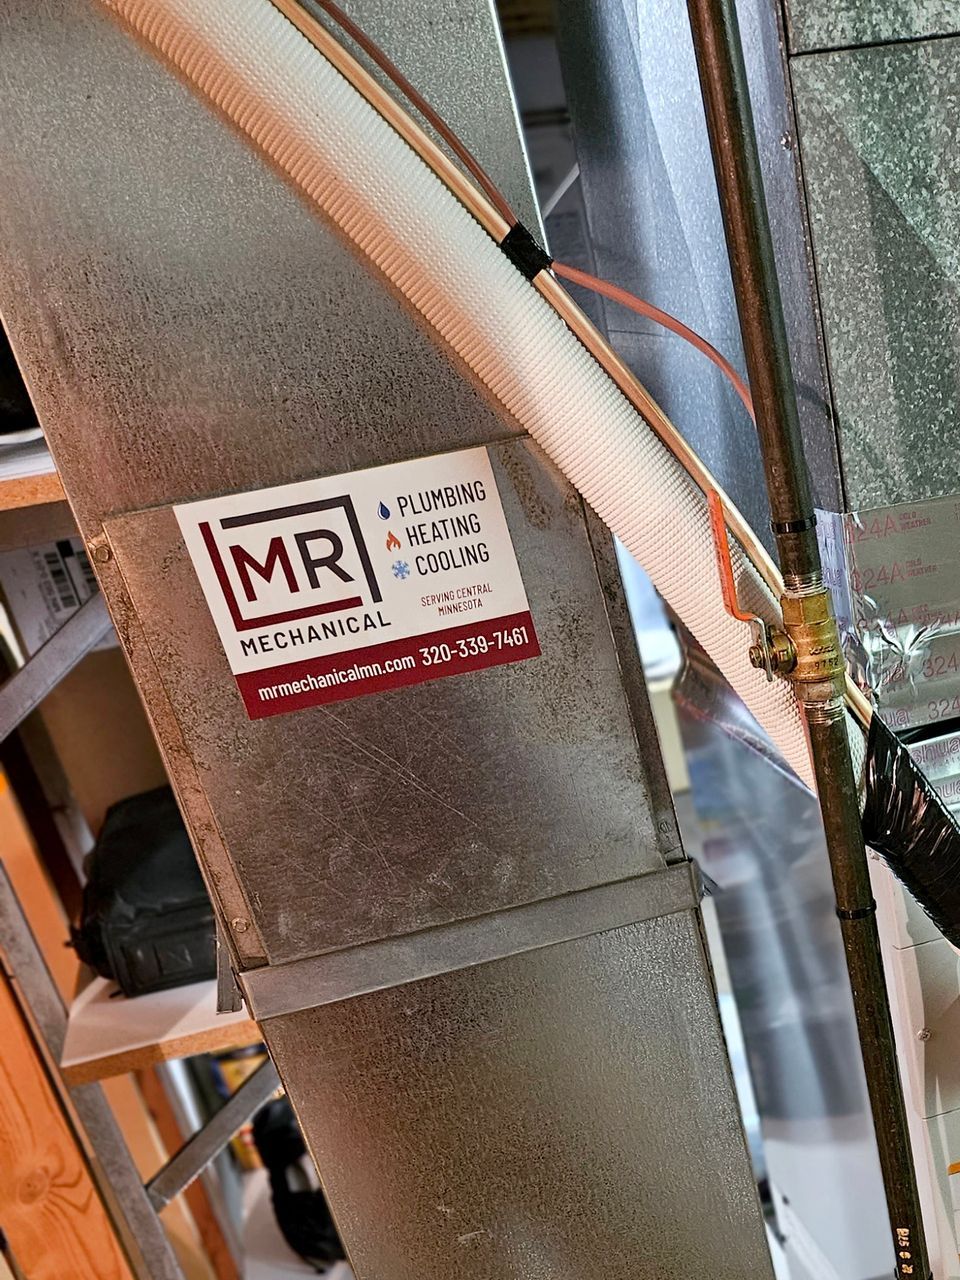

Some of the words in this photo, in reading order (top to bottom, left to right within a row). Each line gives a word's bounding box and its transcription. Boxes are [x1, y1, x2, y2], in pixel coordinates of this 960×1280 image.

[397, 481, 487, 517] PLUMBING
[405, 513, 481, 547] HEATING
[229, 528, 355, 602] MR
[415, 542, 490, 576] COOLING
[421, 590, 455, 607] SERVING
[456, 582, 492, 599] CENTRAL
[438, 598, 483, 616] MINNESOTA
[240, 611, 392, 657] MECHANICAL
[258, 654, 416, 702] mrmechanicalmn.com
[419, 626, 529, 667] 320-339-7461
